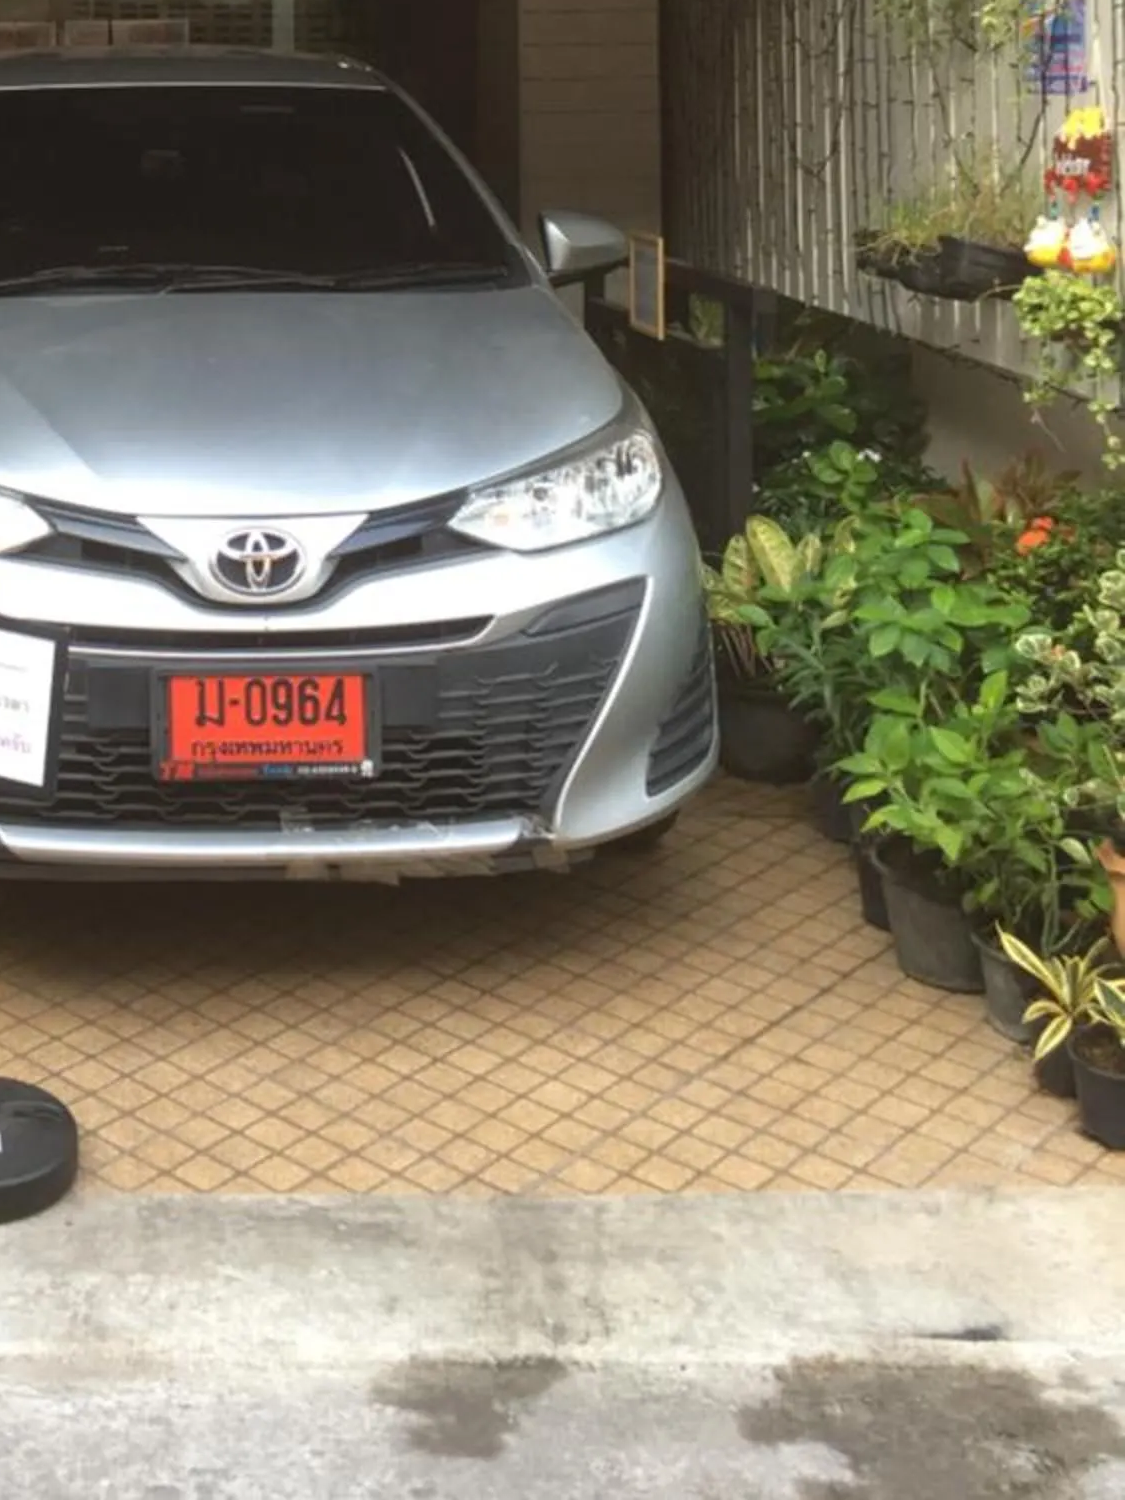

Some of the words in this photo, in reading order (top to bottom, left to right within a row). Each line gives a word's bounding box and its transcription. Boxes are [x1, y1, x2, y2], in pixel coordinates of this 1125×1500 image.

[190, 739, 344, 759] กรุงเทพมหานคร
